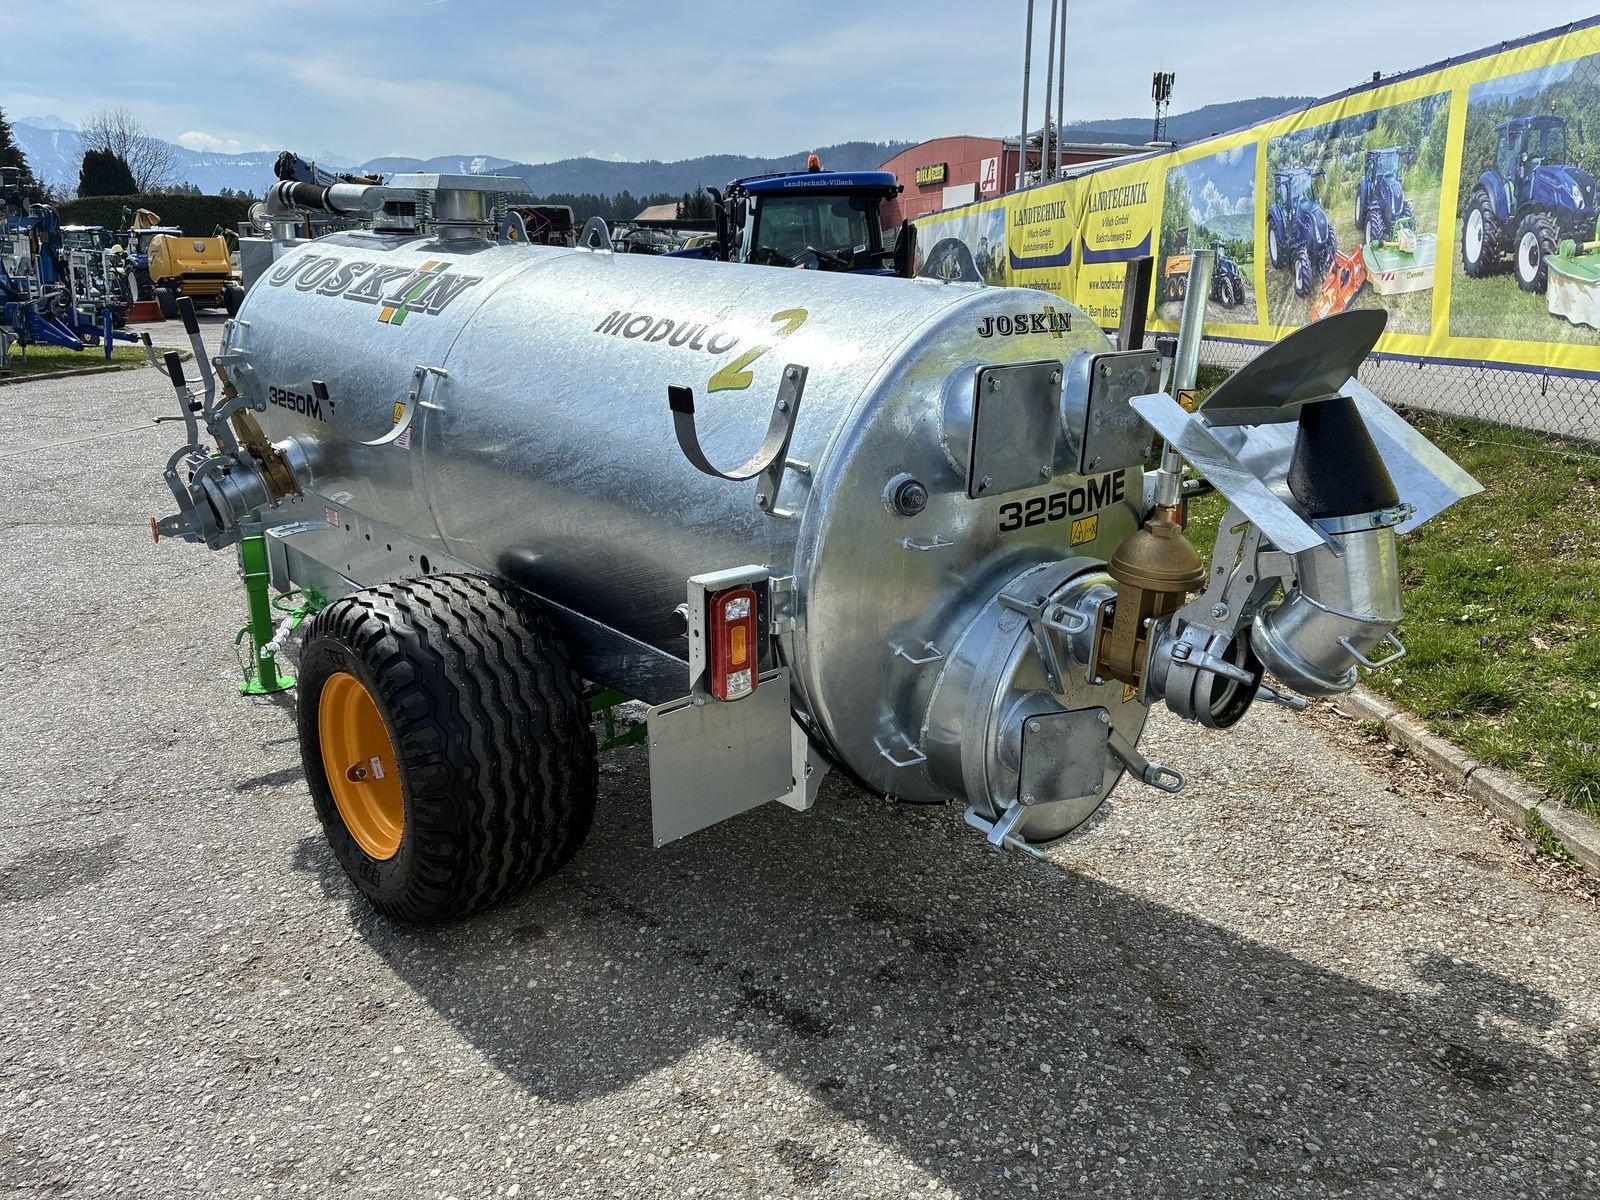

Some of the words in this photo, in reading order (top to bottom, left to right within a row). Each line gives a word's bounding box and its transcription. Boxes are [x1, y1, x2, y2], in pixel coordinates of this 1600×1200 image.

[784, 179, 853, 187] Landtechnik-Villach
[916, 168, 932, 182] BILLA
[1088, 182, 1149, 213] LANDTECHNIK
[1013, 200, 1066, 226] LANDTECHNIK
[1115, 214, 1129, 225] GmbH
[1048, 240, 1054, 249] 63
[1125, 229, 1132, 240] 63
[269, 254, 484, 316] JOSKIN
[1088, 305, 1101, 317] Team
[1103, 304, 1118, 318] Ihres
[978, 312, 1072, 338] JOSKIN
[593, 310, 740, 354] MODULO
[707, 308, 809, 393] 2
[269, 386, 335, 422] 3250M
[999, 469, 1126, 532] 3250ME
